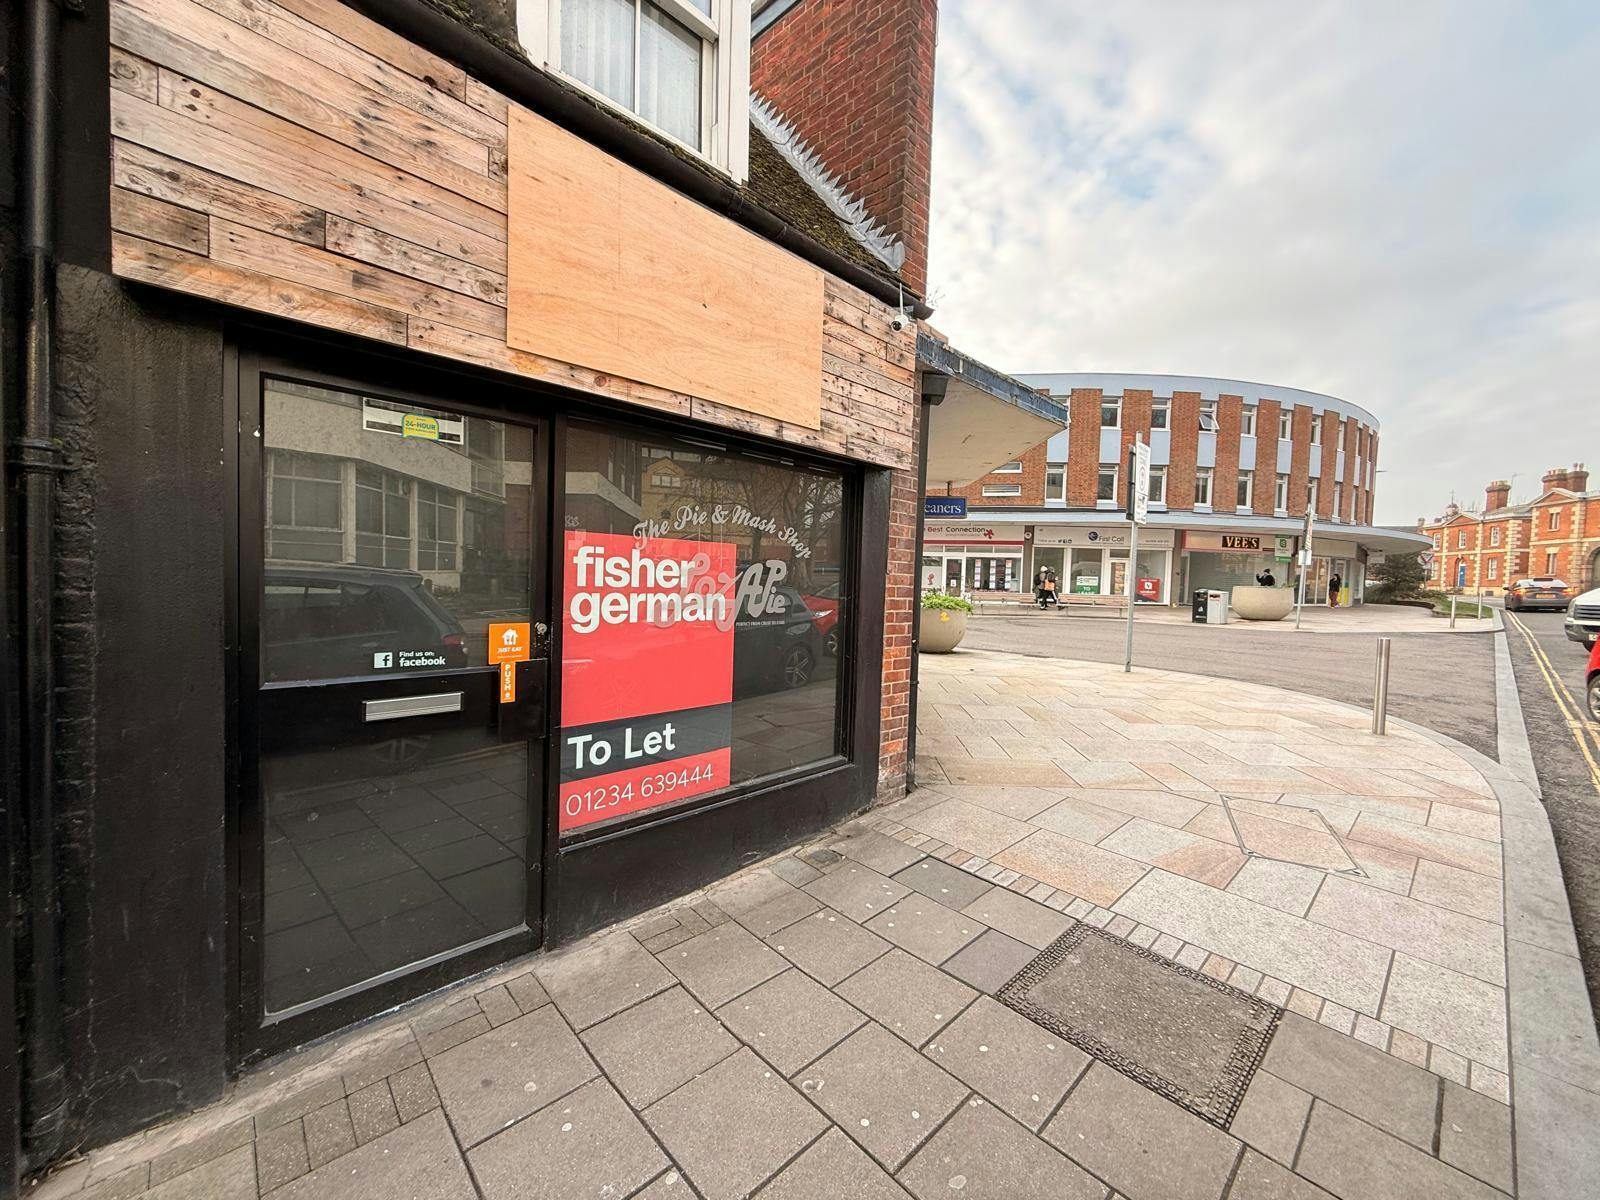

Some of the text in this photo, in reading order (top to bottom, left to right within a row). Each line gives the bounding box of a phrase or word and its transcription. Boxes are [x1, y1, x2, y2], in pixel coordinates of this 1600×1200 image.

[405, 419, 436, 430] 24-HOUR
[632, 504, 813, 559] The Pie & Mash Shop
[1225, 536, 1258, 549] VEE'S
[572, 545, 696, 589] fisher
[569, 591, 726, 634] german
[399, 656, 446, 667] facebook
[497, 646, 511, 654] JUST
[567, 722, 676, 770] To Let
[565, 762, 714, 816] 01234 639444
